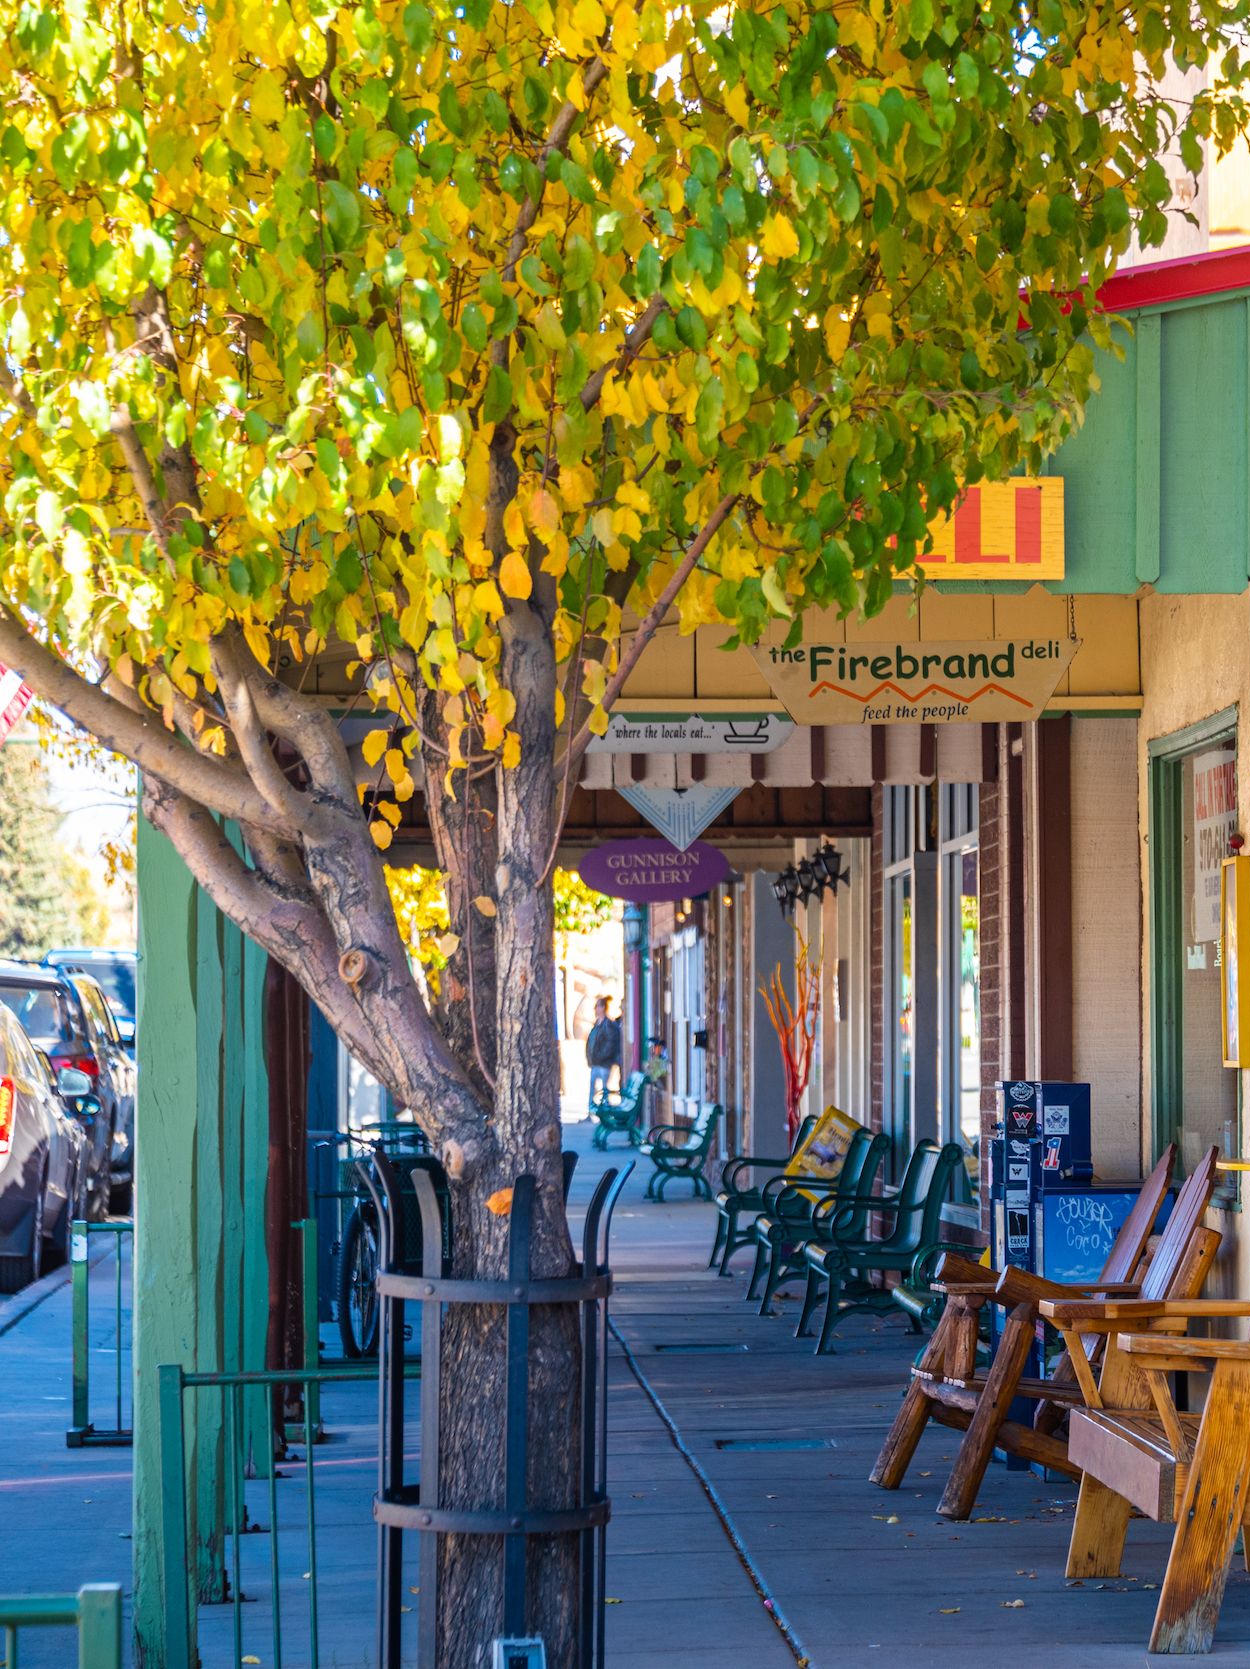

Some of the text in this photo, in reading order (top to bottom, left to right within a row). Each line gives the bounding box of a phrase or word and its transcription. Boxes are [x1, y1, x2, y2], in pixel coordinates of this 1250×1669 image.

[768, 641, 1060, 682] the Firebrand deli
[861, 703, 969, 723] feed the people
[645, 725, 658, 738] the
[661, 725, 687, 738] locals
[607, 852, 700, 869] GUNNISON
[616, 870, 692, 885] GALLERY
